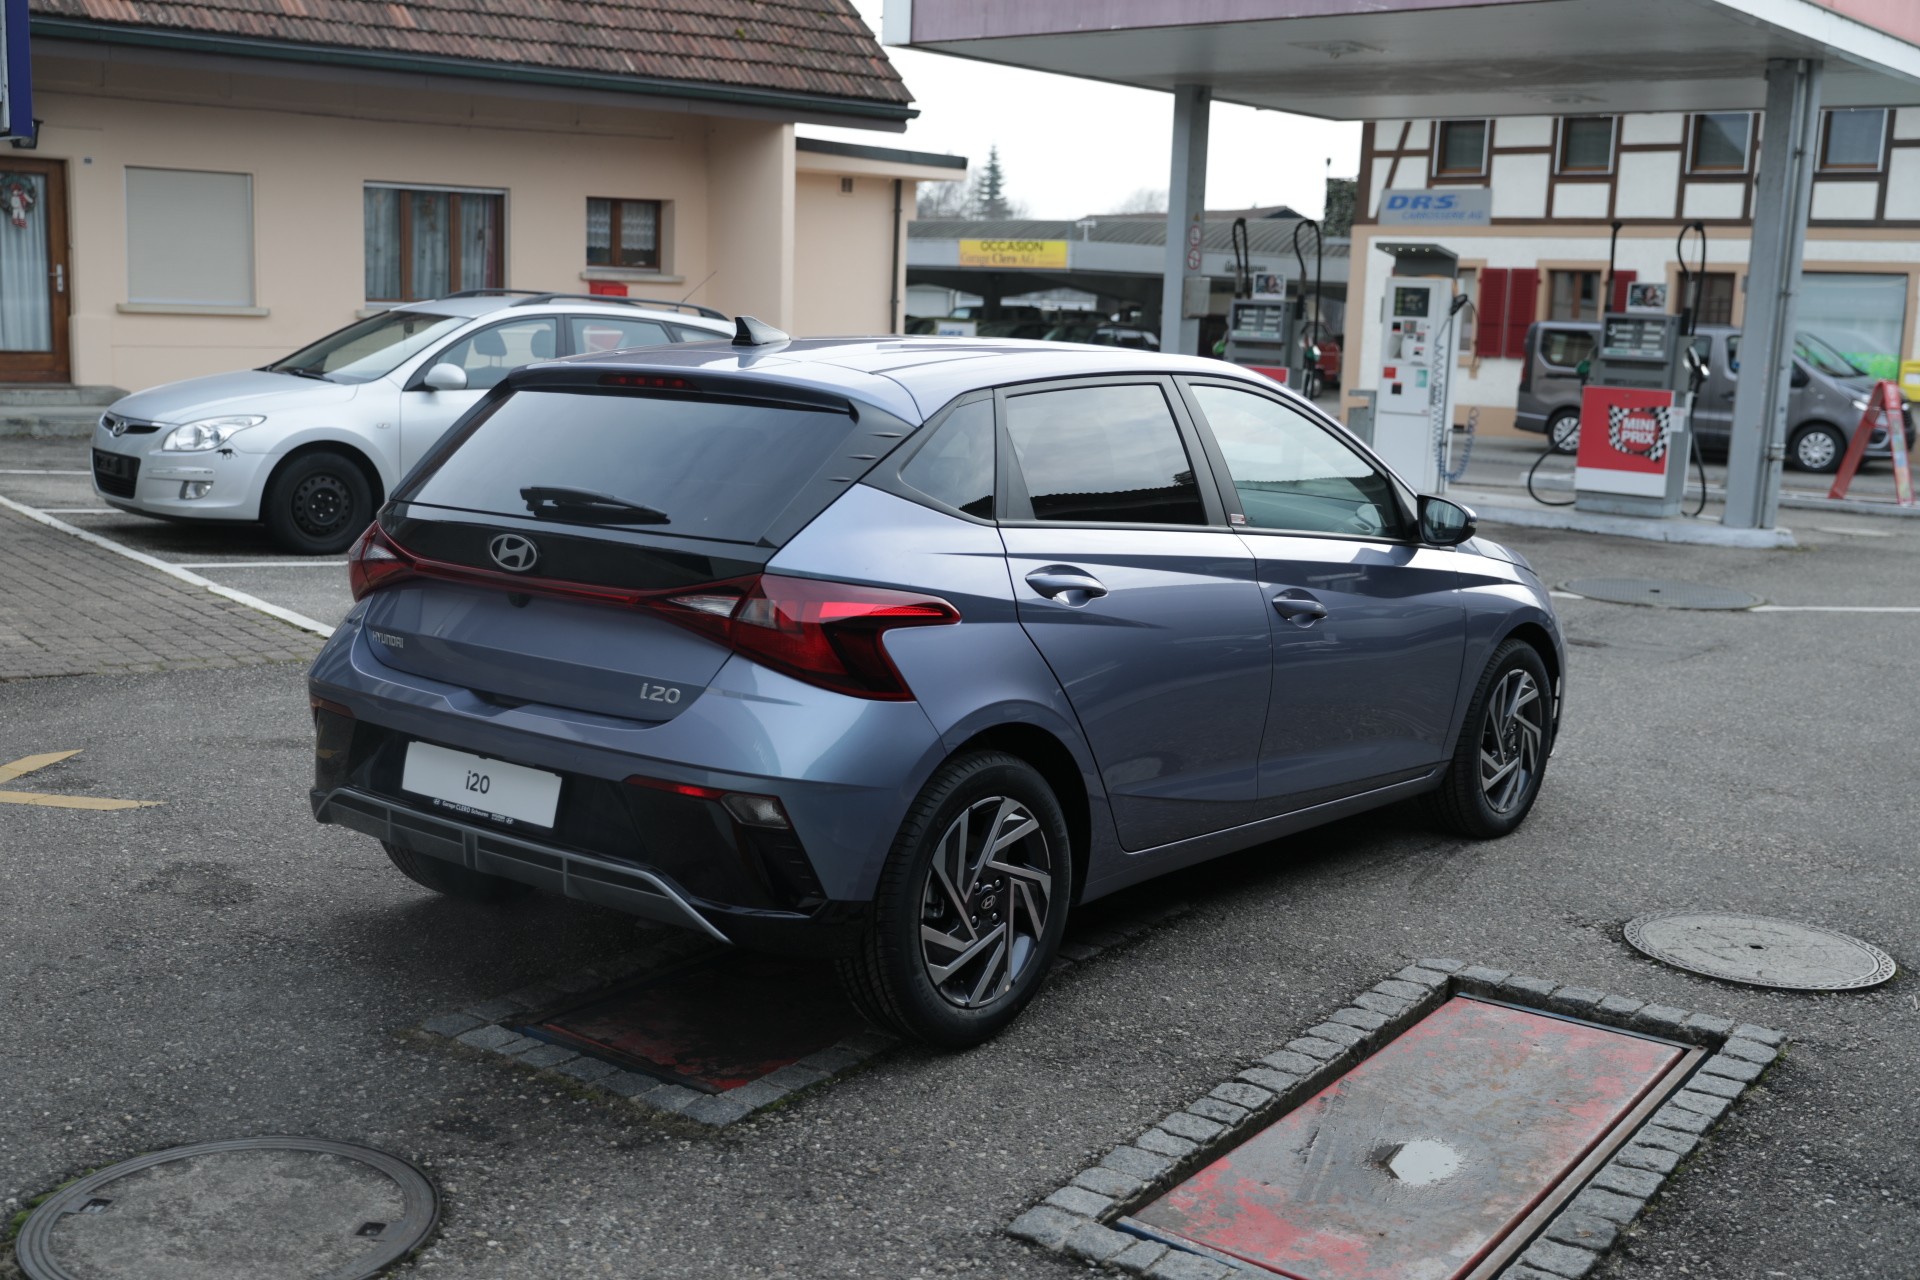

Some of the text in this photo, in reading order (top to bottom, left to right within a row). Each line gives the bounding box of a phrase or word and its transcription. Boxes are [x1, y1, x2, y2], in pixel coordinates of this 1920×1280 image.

[1387, 194, 1456, 210] DRS
[980, 240, 1044, 252] OCCASION
[1622, 417, 1656, 431] MINI
[1621, 430, 1655, 445] PRIX
[372, 630, 404, 649] HYUNDAI
[465, 769, 491, 795] i20
